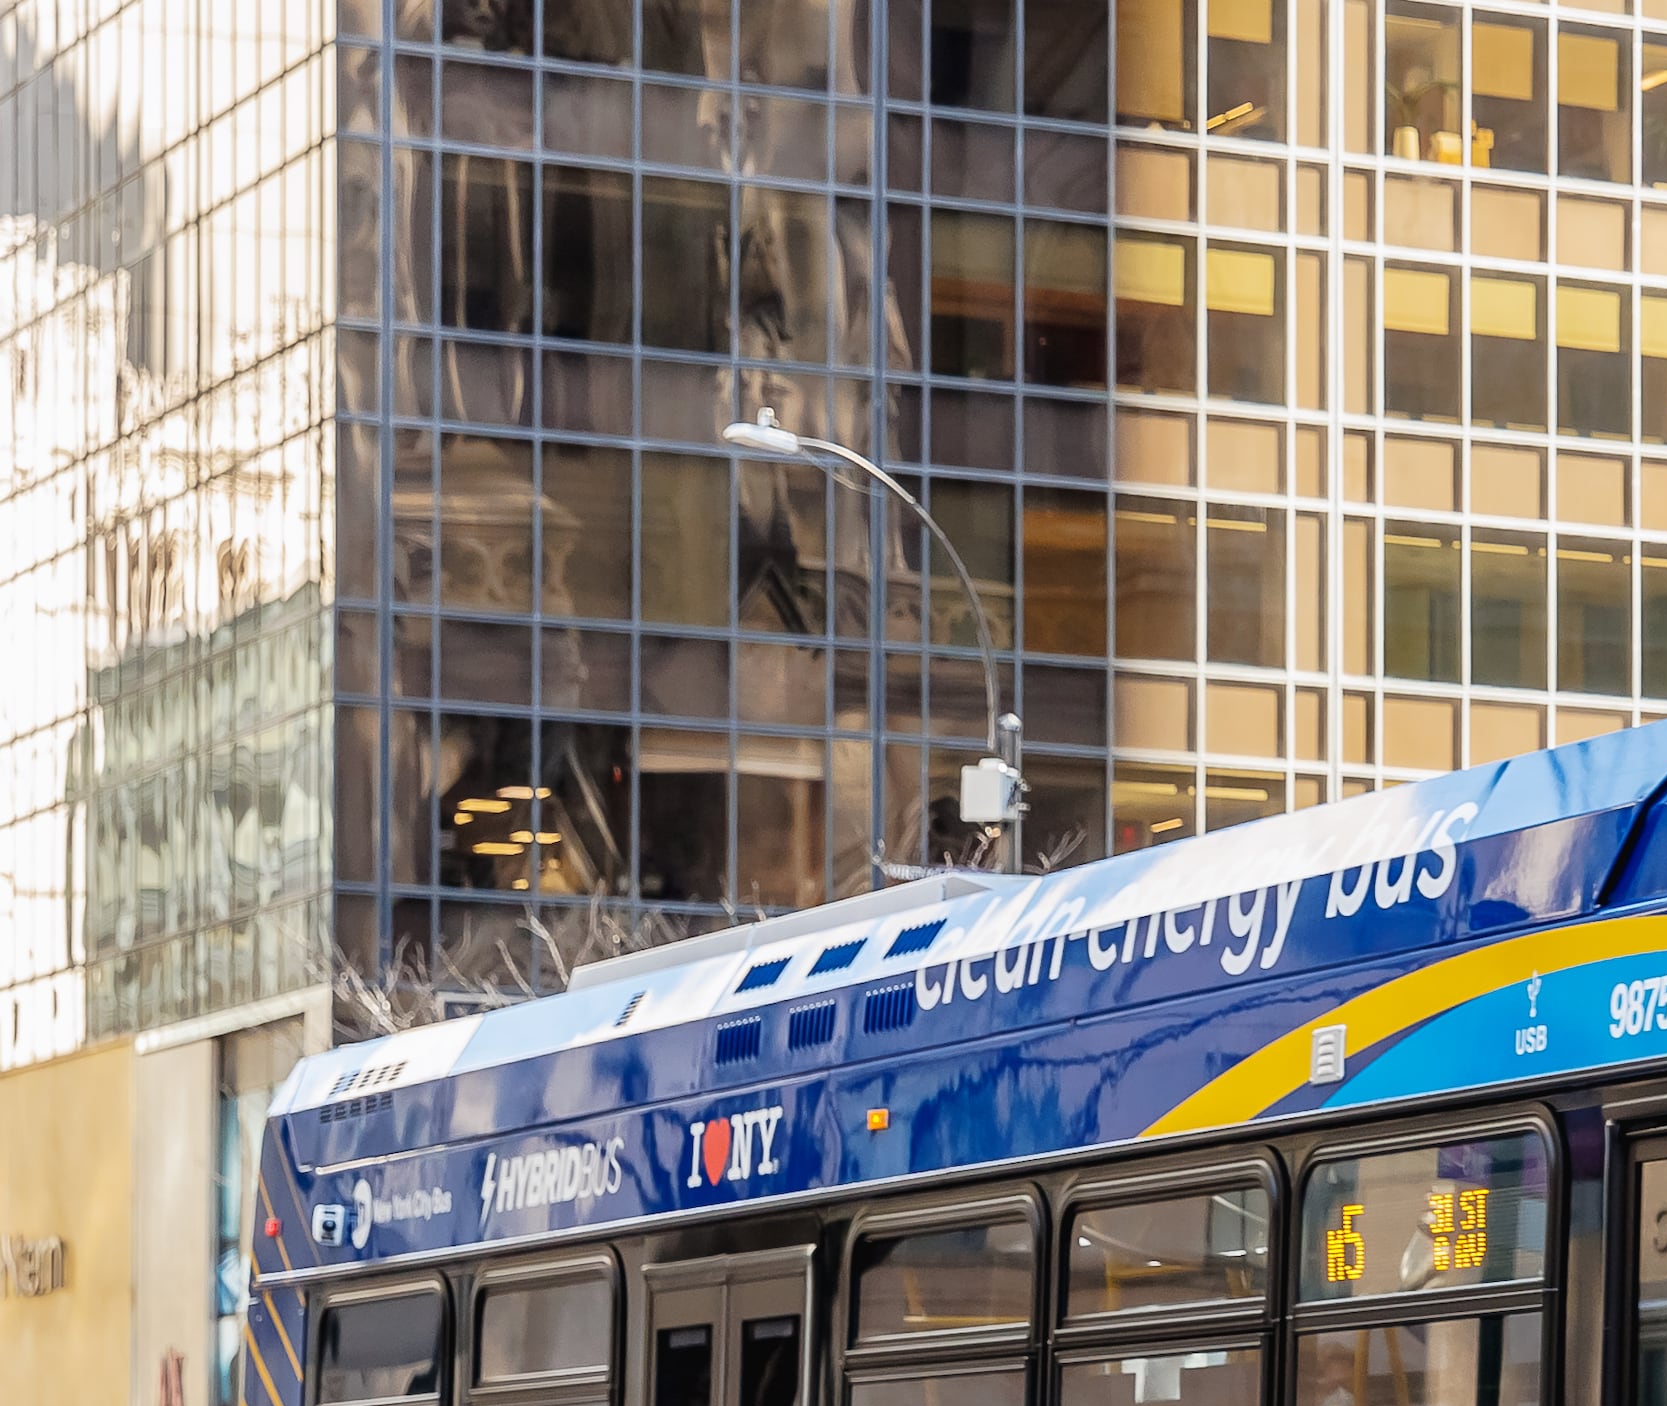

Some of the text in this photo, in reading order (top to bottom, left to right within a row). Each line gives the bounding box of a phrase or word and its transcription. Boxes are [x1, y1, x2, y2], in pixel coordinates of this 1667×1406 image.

[914, 802, 1479, 1010] clean-energy bus
[1515, 1025, 1548, 1056] USB
